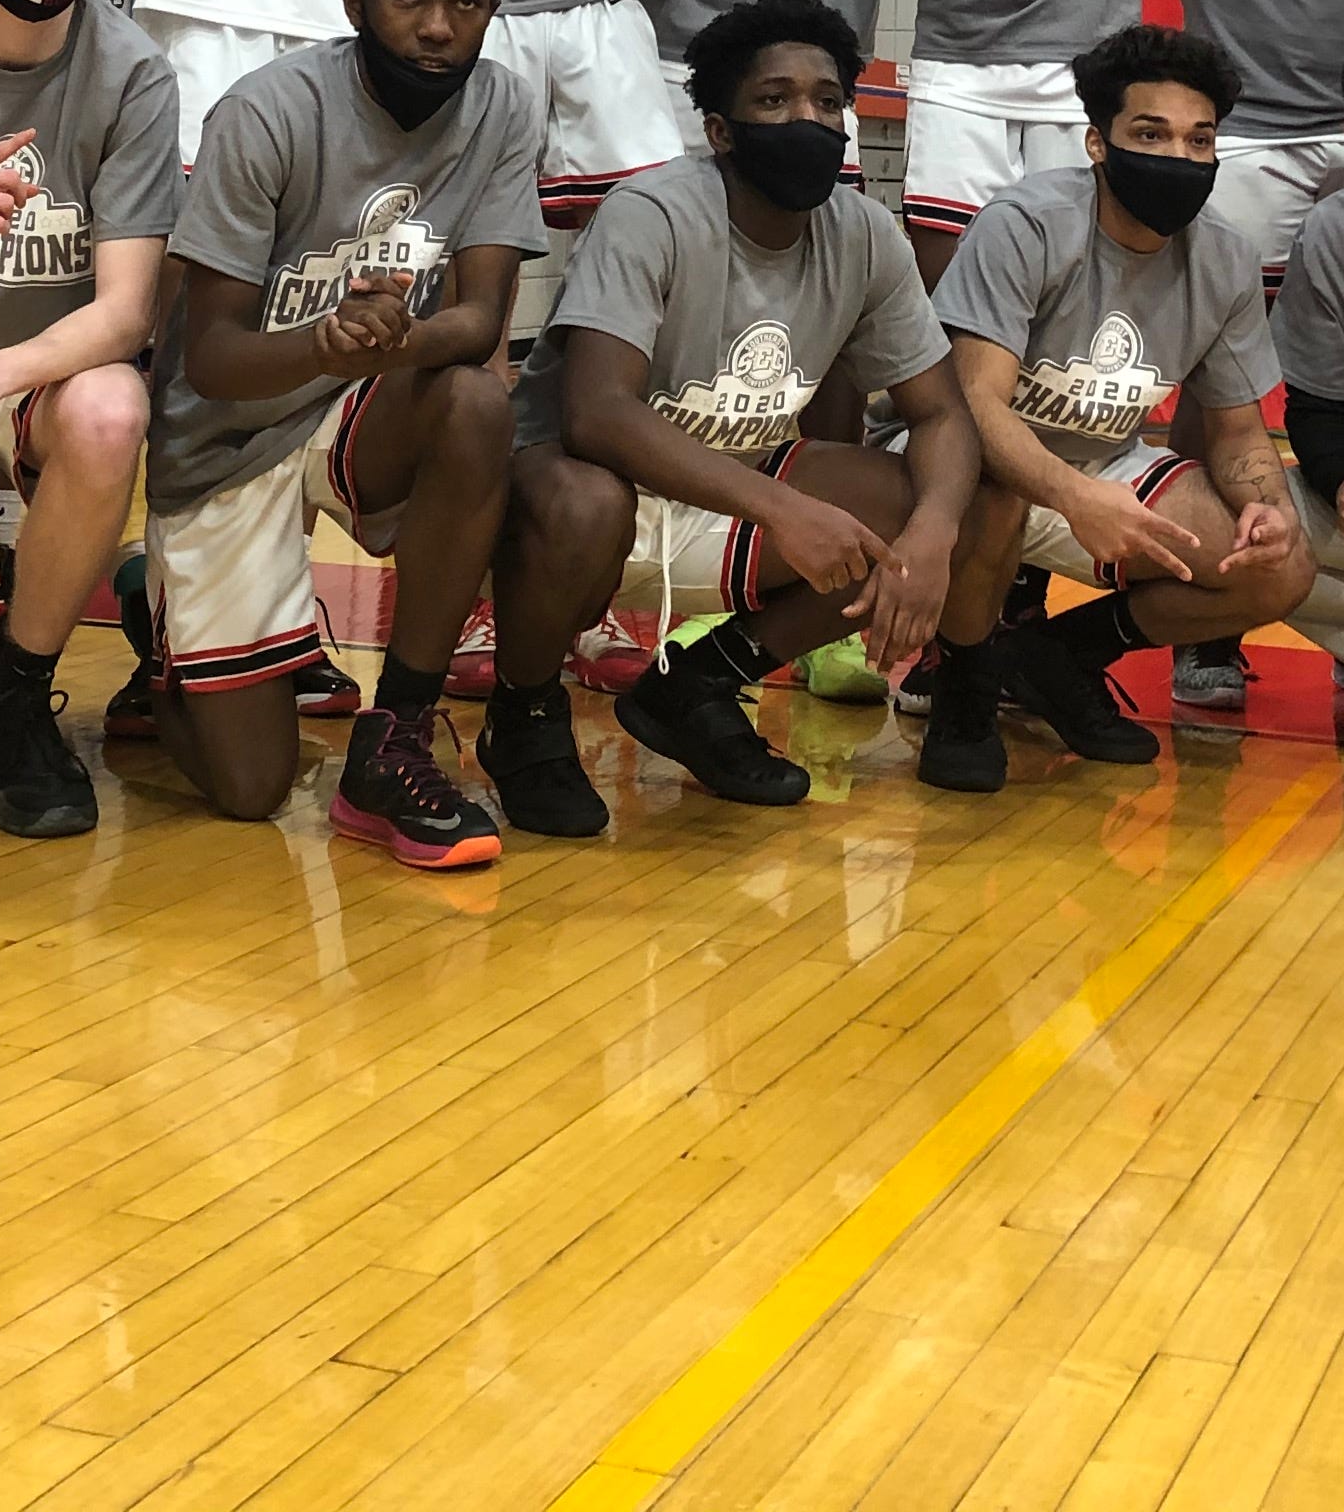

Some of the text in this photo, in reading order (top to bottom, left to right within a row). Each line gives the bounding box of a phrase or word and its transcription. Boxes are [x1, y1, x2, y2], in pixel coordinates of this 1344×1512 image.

[736, 346, 784, 378] SEC
[715, 391, 786, 414] 2020
[1069, 378, 1142, 403] 2020
